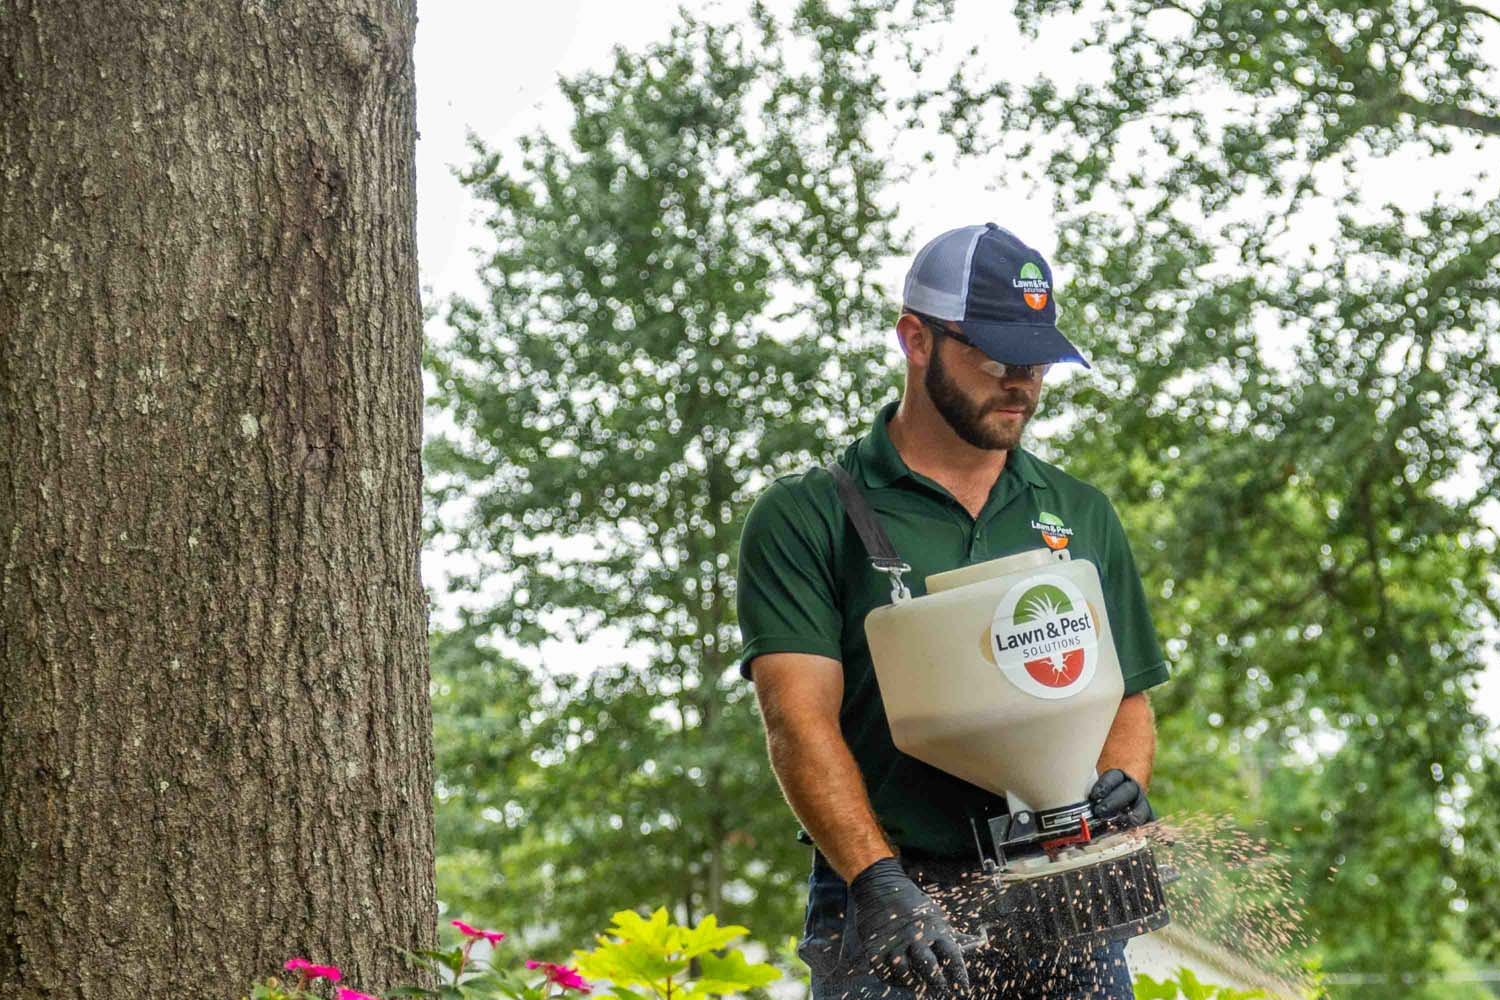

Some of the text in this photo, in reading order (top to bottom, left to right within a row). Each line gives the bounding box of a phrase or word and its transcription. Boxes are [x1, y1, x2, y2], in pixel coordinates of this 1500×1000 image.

[995, 612, 1092, 652] Lawn & Pest
[1022, 635, 1081, 659] SOLUTIONS
